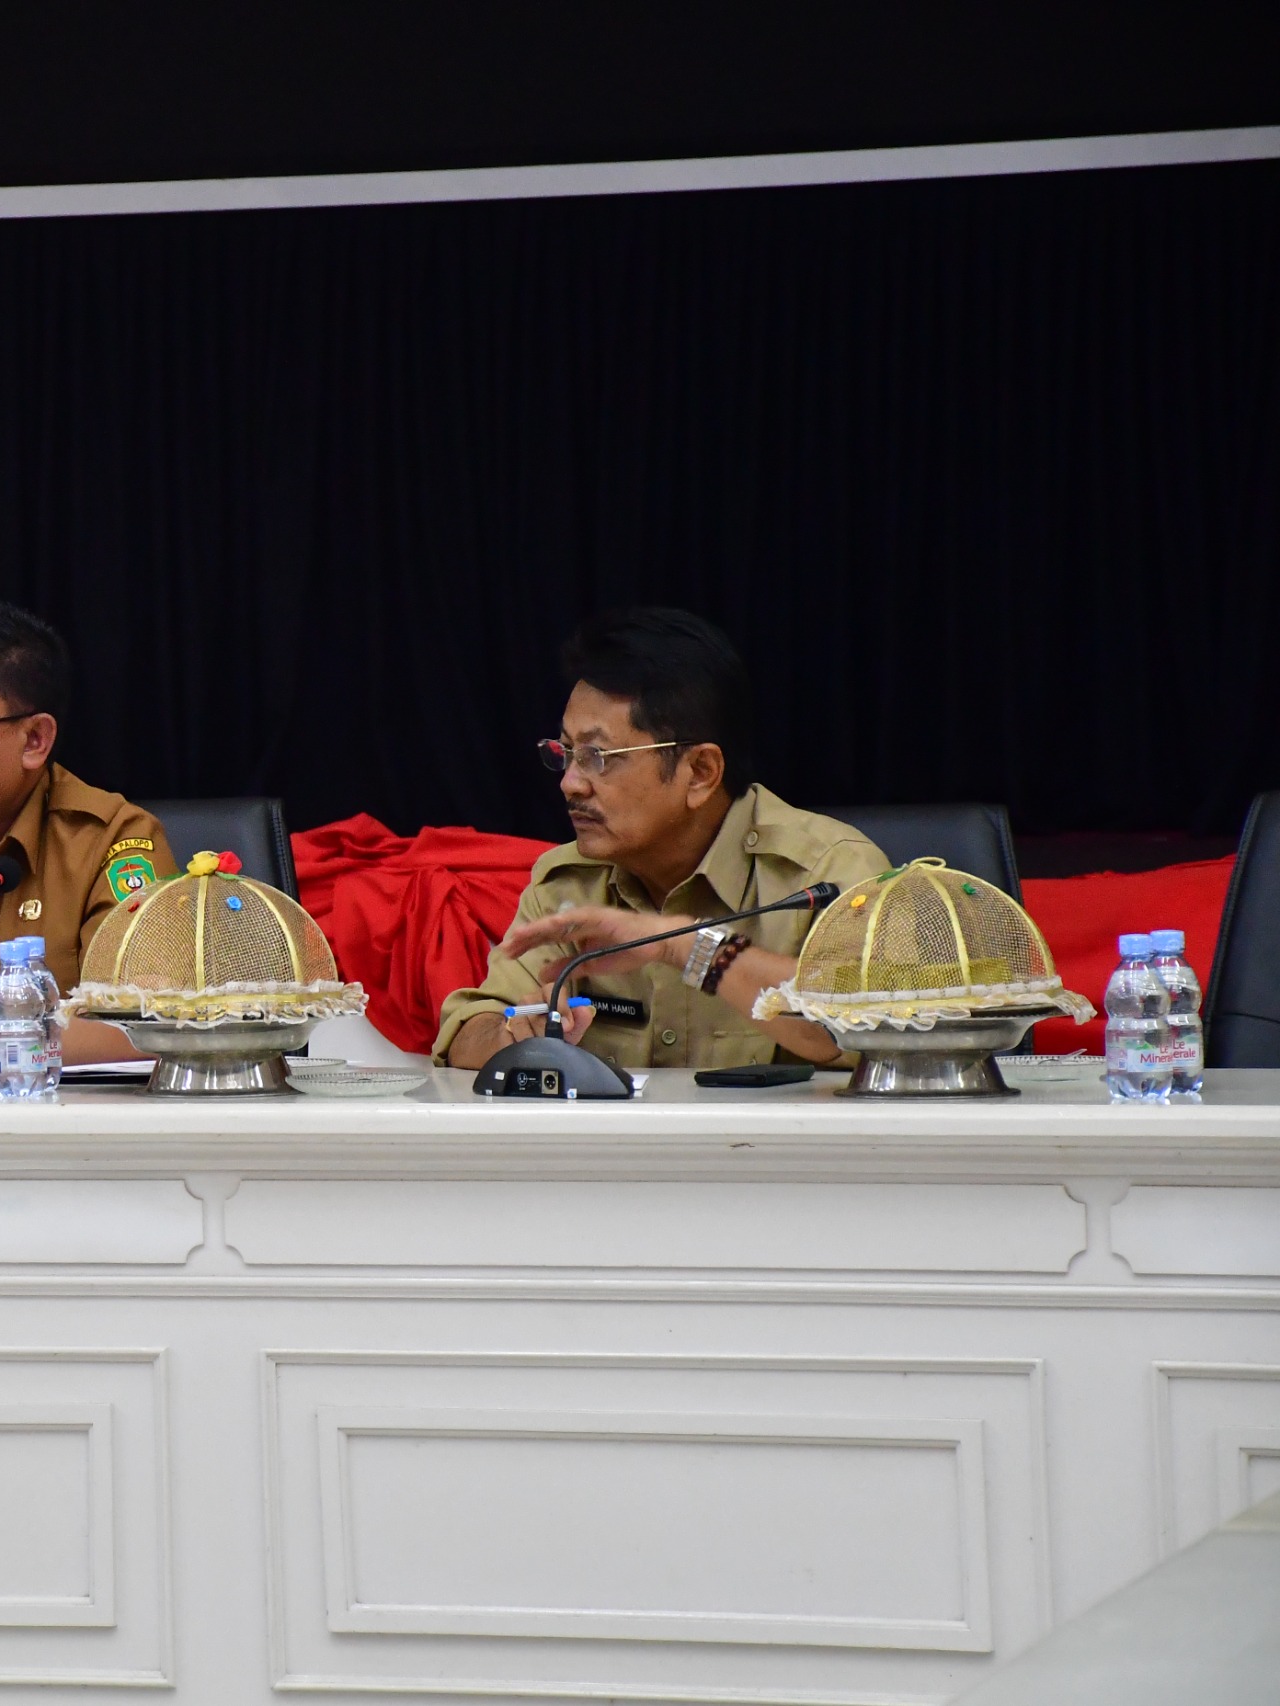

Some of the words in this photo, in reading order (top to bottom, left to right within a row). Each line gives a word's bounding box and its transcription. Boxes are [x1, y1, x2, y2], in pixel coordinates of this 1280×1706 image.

[119, 840, 150, 849] PALOPO
[592, 1000, 609, 1011] HAM
[611, 1003, 636, 1016] HAMID
